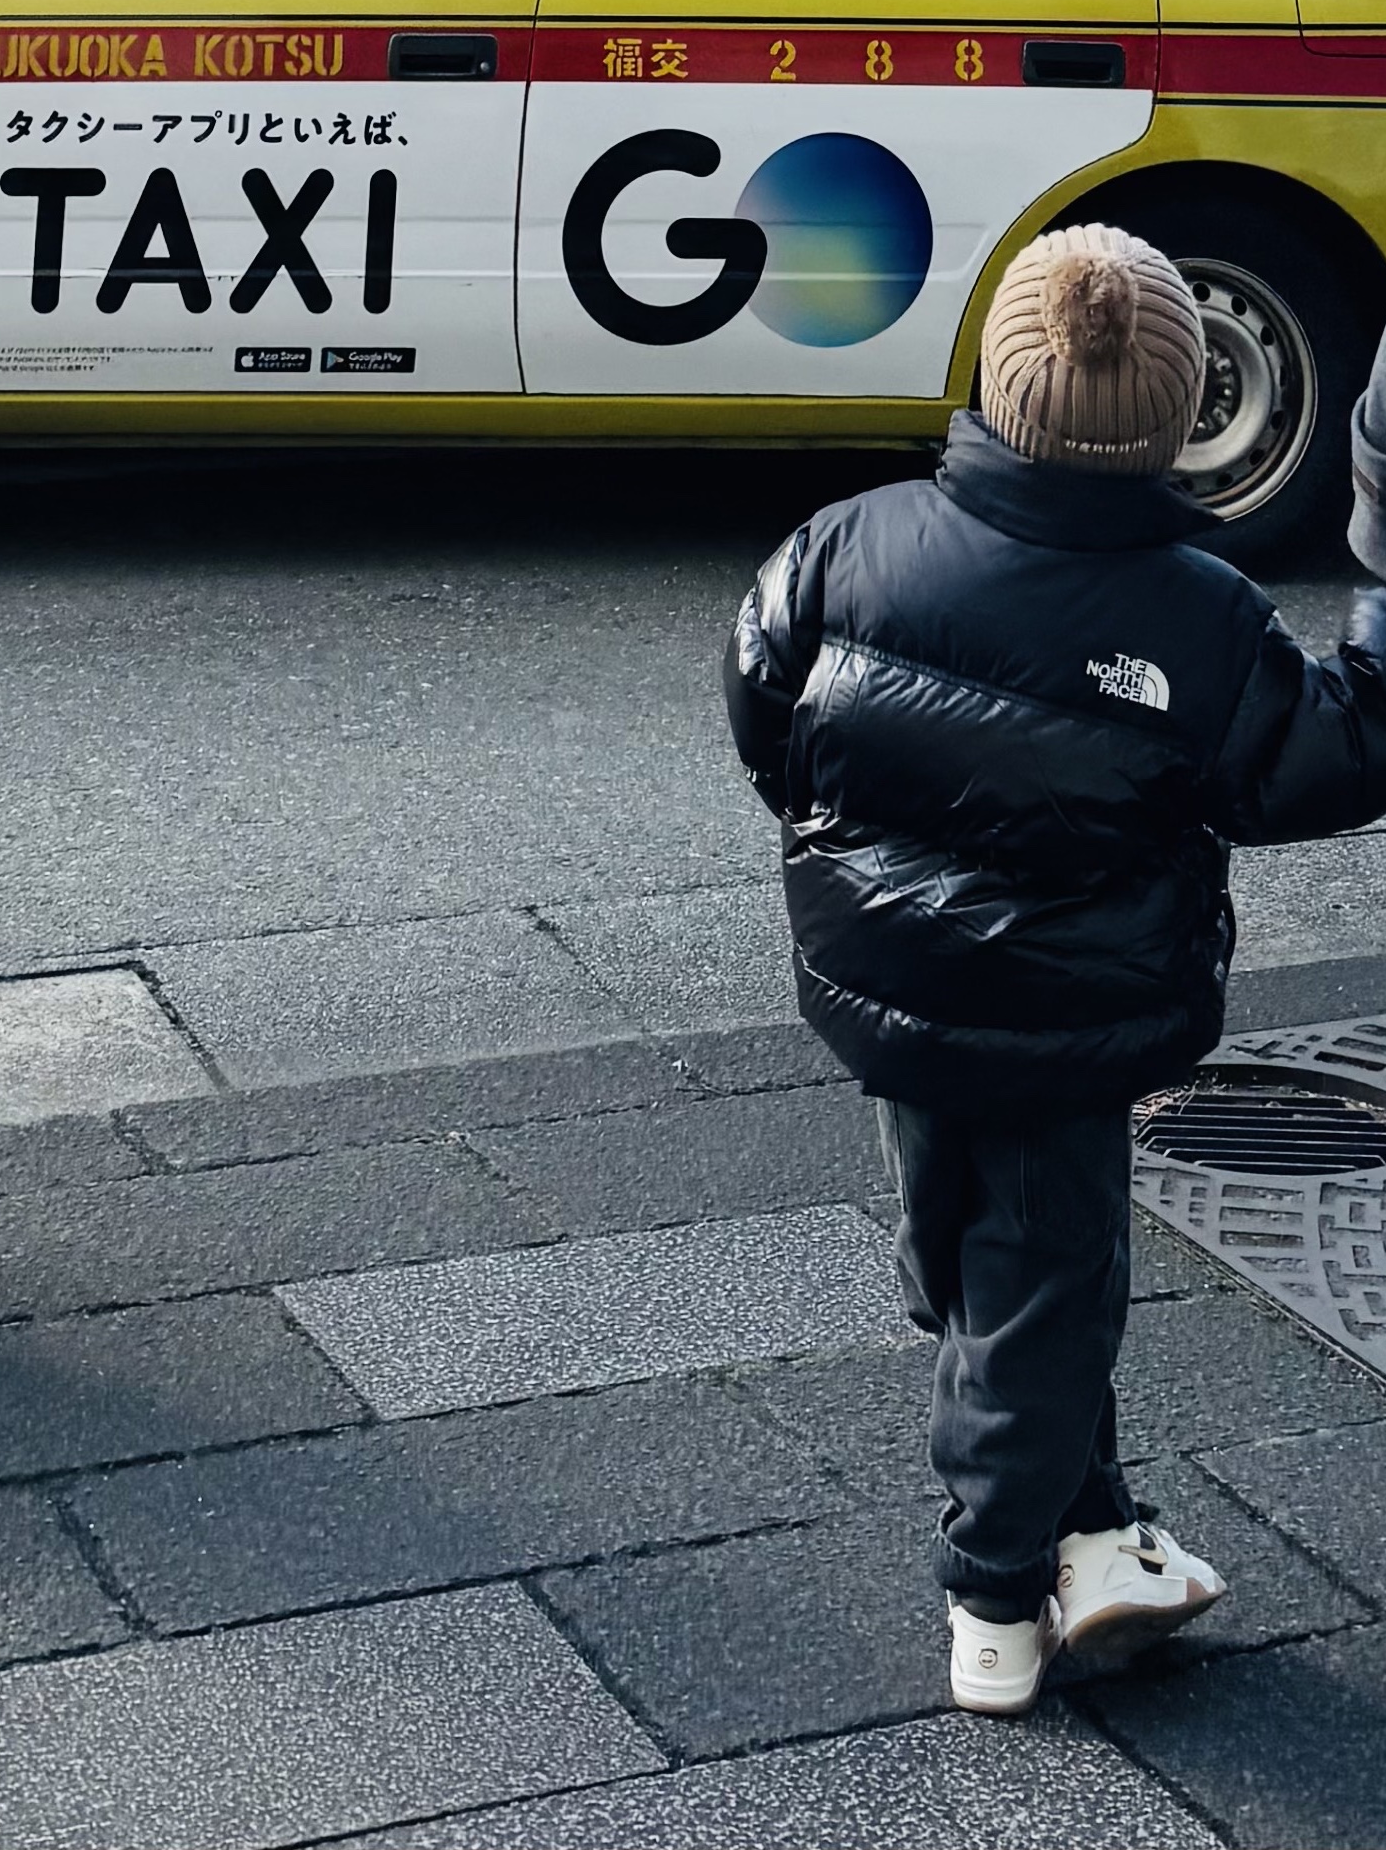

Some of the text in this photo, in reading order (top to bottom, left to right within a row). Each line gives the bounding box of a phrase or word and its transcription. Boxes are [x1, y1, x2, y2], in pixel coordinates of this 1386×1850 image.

[193, 33, 345, 78] KOTSU
[603, 37, 690, 79] 福交
[6, 108, 410, 147] タクシーアプリといえば、
[0, 167, 398, 315] TAXI
[562, 127, 934, 348] GO
[349, 351, 403, 364] Google Play
[1086, 659, 1144, 689] NORTH
[1115, 653, 1147, 674] THE
[1099, 679, 1142, 703] FACE
